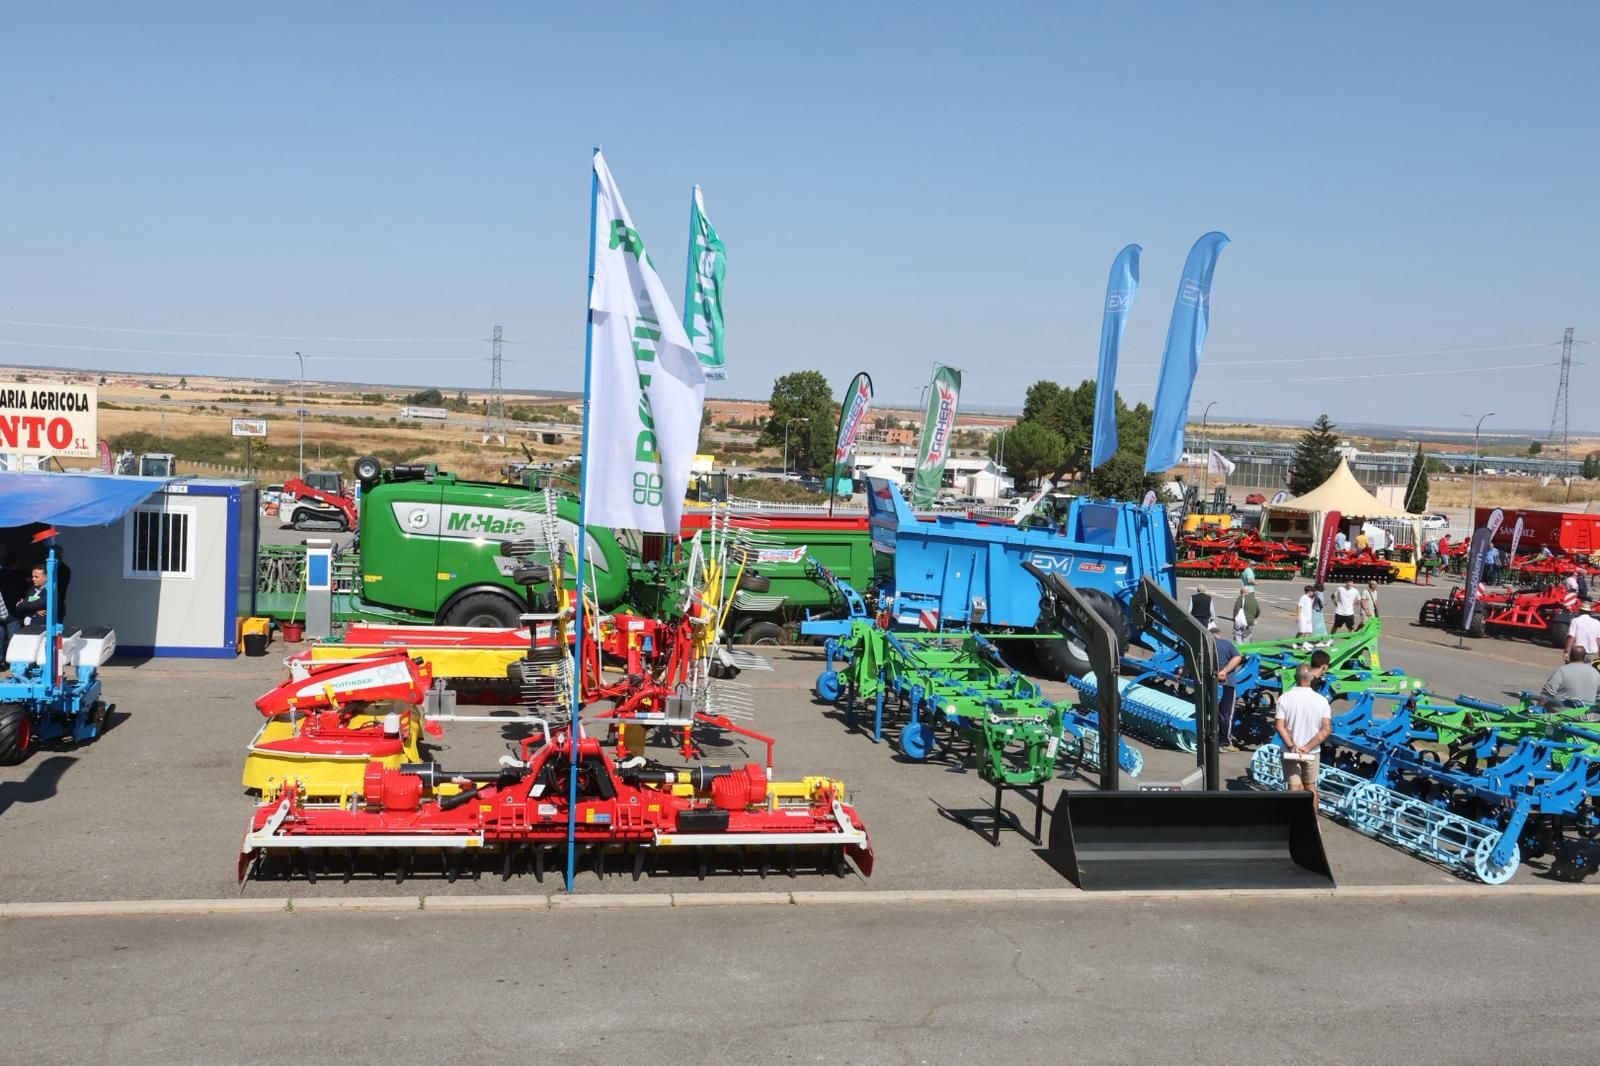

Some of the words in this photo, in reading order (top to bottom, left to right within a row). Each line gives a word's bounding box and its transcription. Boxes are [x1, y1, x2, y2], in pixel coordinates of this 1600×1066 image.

[30, 391, 89, 412] AGRICOLA
[931, 400, 950, 453] GAHER
[75, 438, 89, 450] S.L.
[414, 514, 424, 523] 4
[1469, 553, 1483, 603] özdöken
